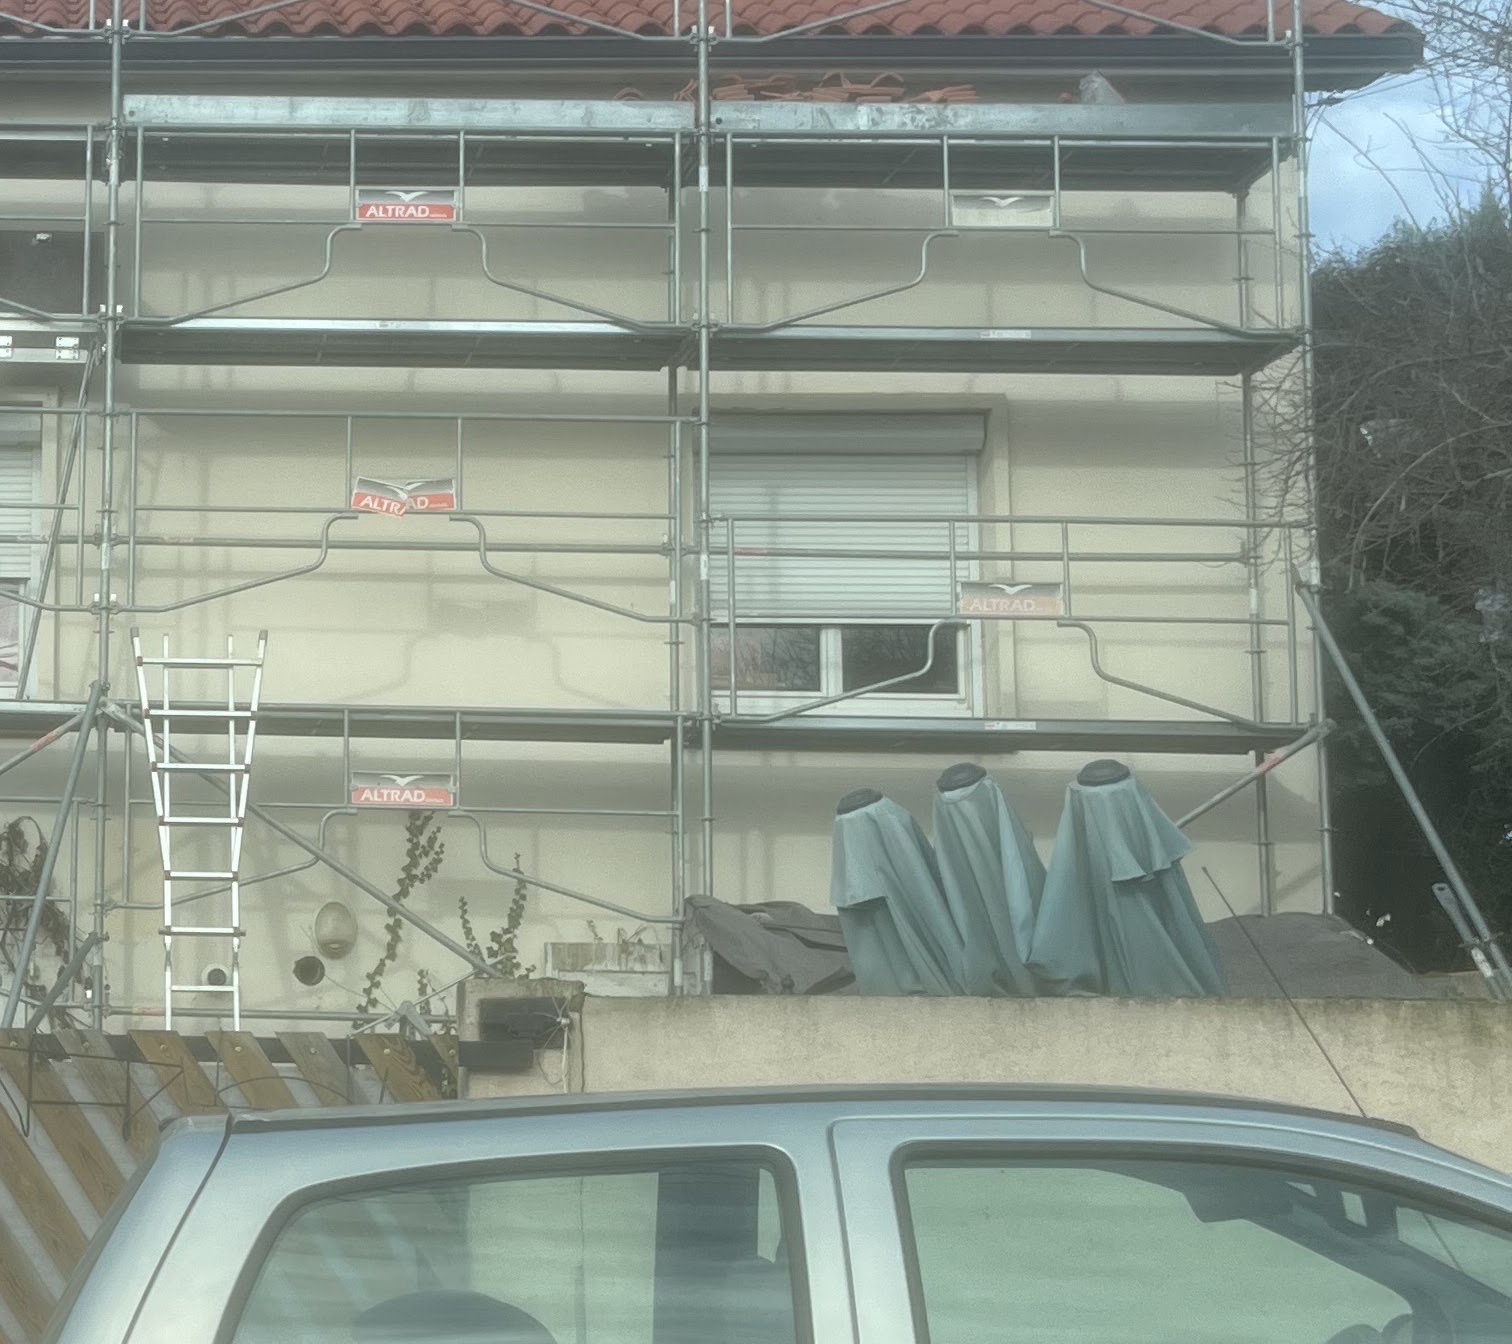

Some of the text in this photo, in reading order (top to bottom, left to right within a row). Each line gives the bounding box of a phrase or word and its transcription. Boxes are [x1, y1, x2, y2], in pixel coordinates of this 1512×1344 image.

[365, 205, 430, 217] ALTRAD
[969, 598, 1034, 611] ALTRAD
[359, 788, 425, 804] ALTRAD
